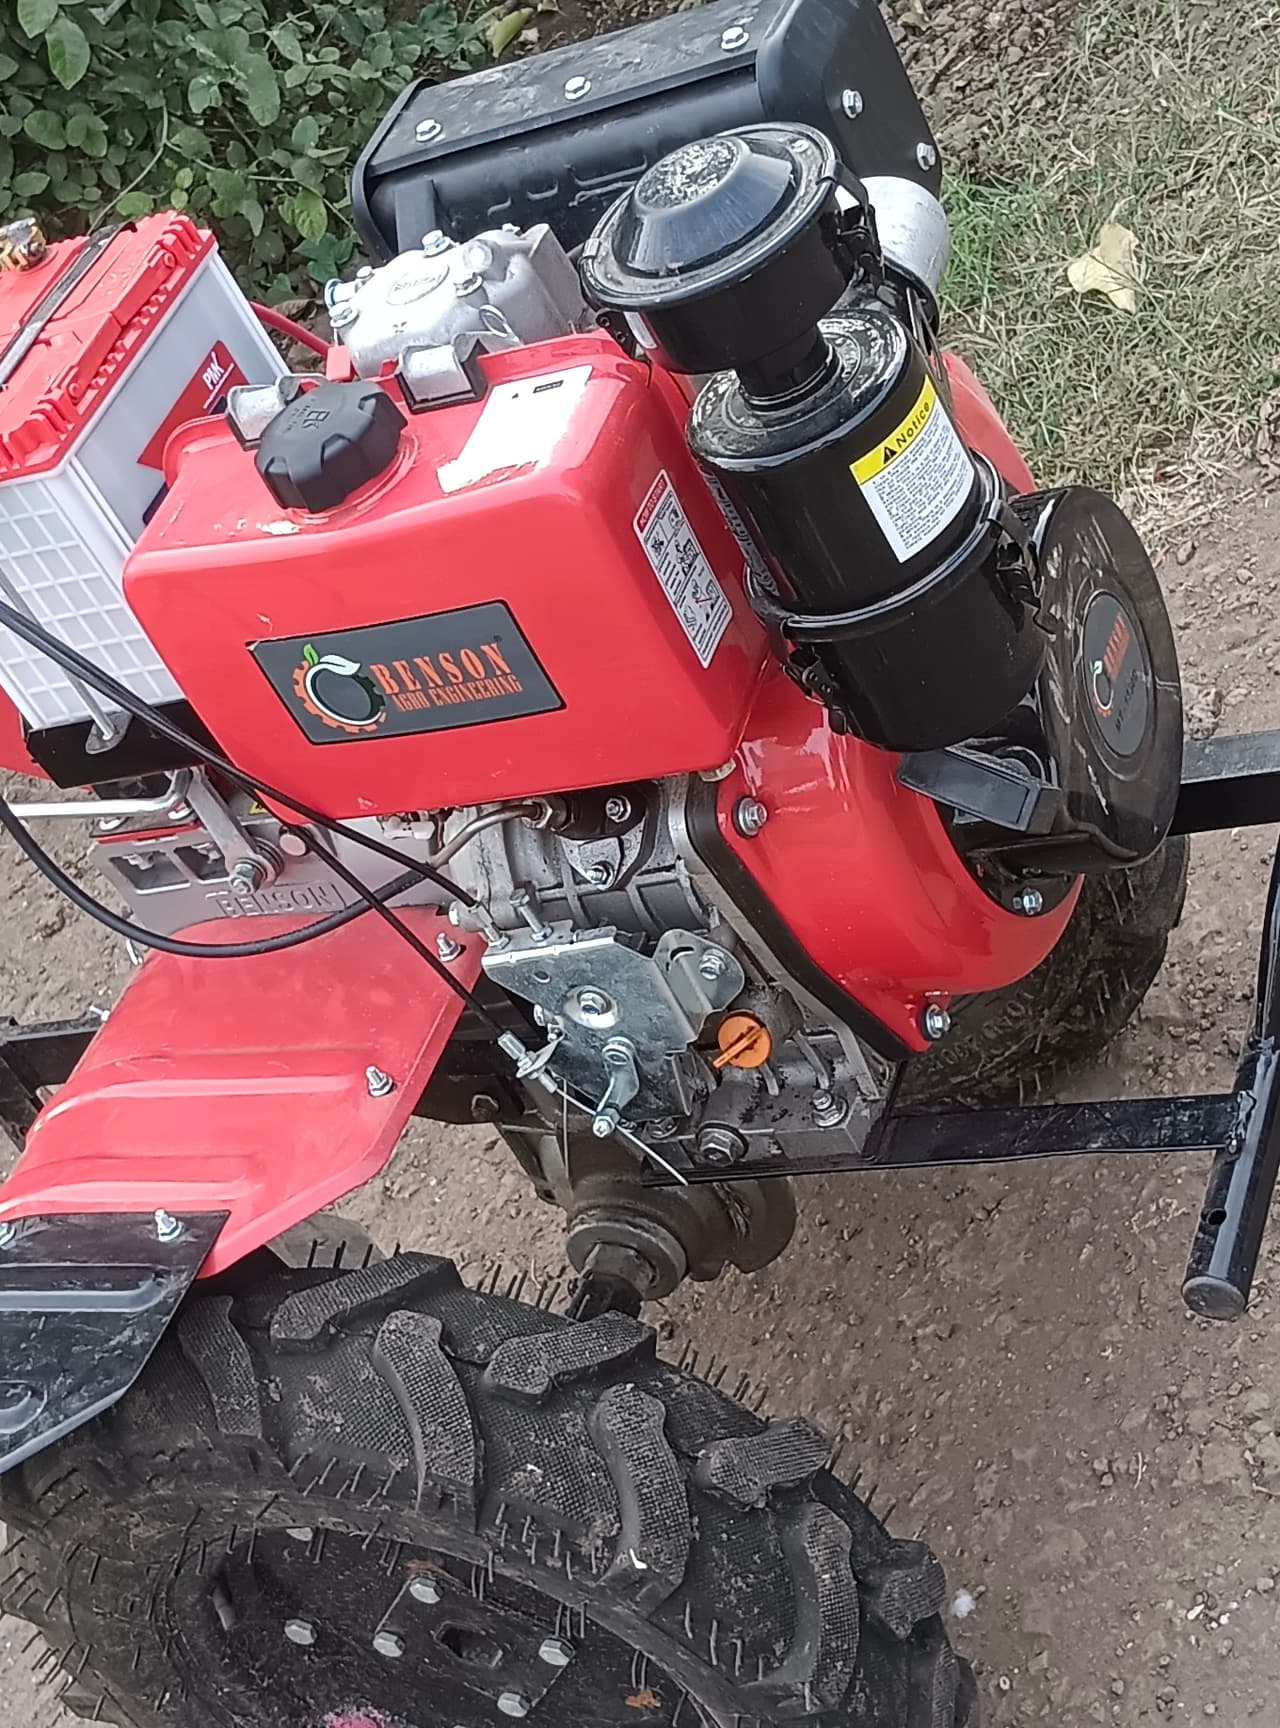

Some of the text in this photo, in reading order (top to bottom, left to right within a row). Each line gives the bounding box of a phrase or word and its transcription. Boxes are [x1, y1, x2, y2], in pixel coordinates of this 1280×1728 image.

[202, 351, 224, 390] PMK
[896, 402, 930, 448] Notice
[370, 642, 512, 695] BENSON
[391, 674, 523, 712] AGRO ENGINEERING
